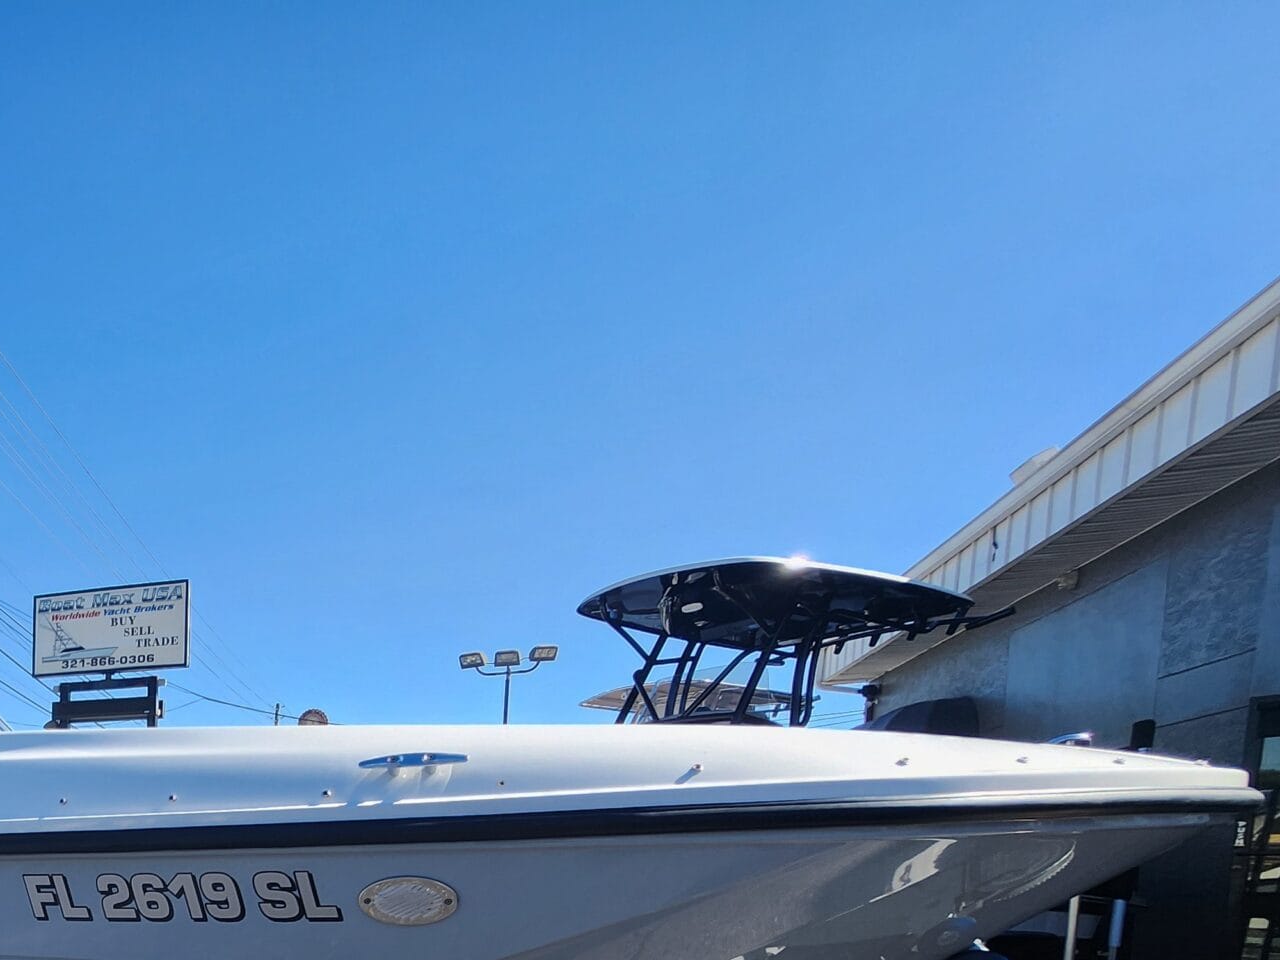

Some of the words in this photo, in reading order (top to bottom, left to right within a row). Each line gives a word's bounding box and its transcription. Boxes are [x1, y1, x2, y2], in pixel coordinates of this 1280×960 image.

[39, 597, 85, 613] Boat
[92, 591, 135, 608] Max
[141, 585, 183, 602] USA
[51, 610, 101, 622] Worldwide
[103, 607, 132, 617] Yacht
[133, 603, 174, 614] Brokers
[111, 616, 137, 627] BUY
[123, 626, 155, 637] SELL
[136, 636, 179, 648] TRADE
[61, 654, 155, 669] 321-866-0306
[23, 873, 93, 921] FL
[95, 872, 246, 921] 2619
[252, 870, 344, 921] SL
